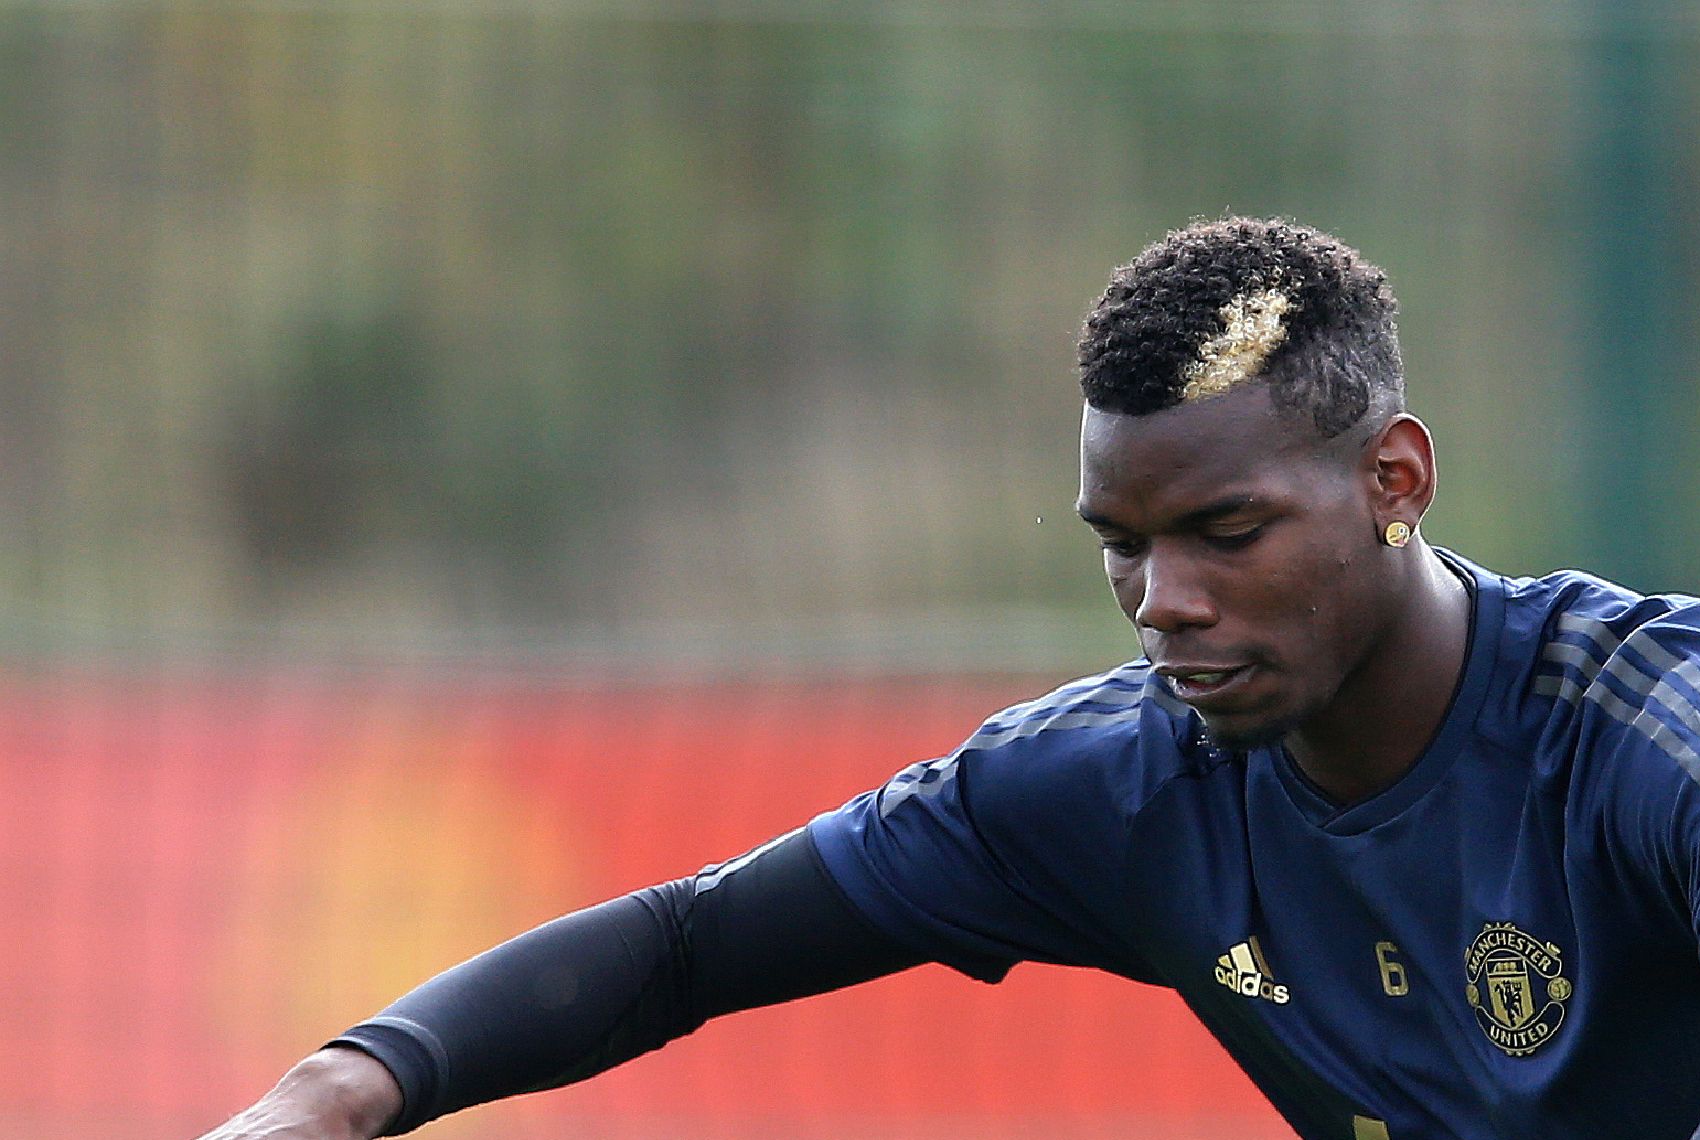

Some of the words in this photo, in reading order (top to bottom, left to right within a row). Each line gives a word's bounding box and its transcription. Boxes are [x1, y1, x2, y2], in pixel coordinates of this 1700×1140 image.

[1375, 941, 1410, 997] 6
[1468, 932, 1552, 975] MANCHESTER
[1214, 965, 1291, 1005] adidas
[1489, 1021, 1549, 1047] UNITED
